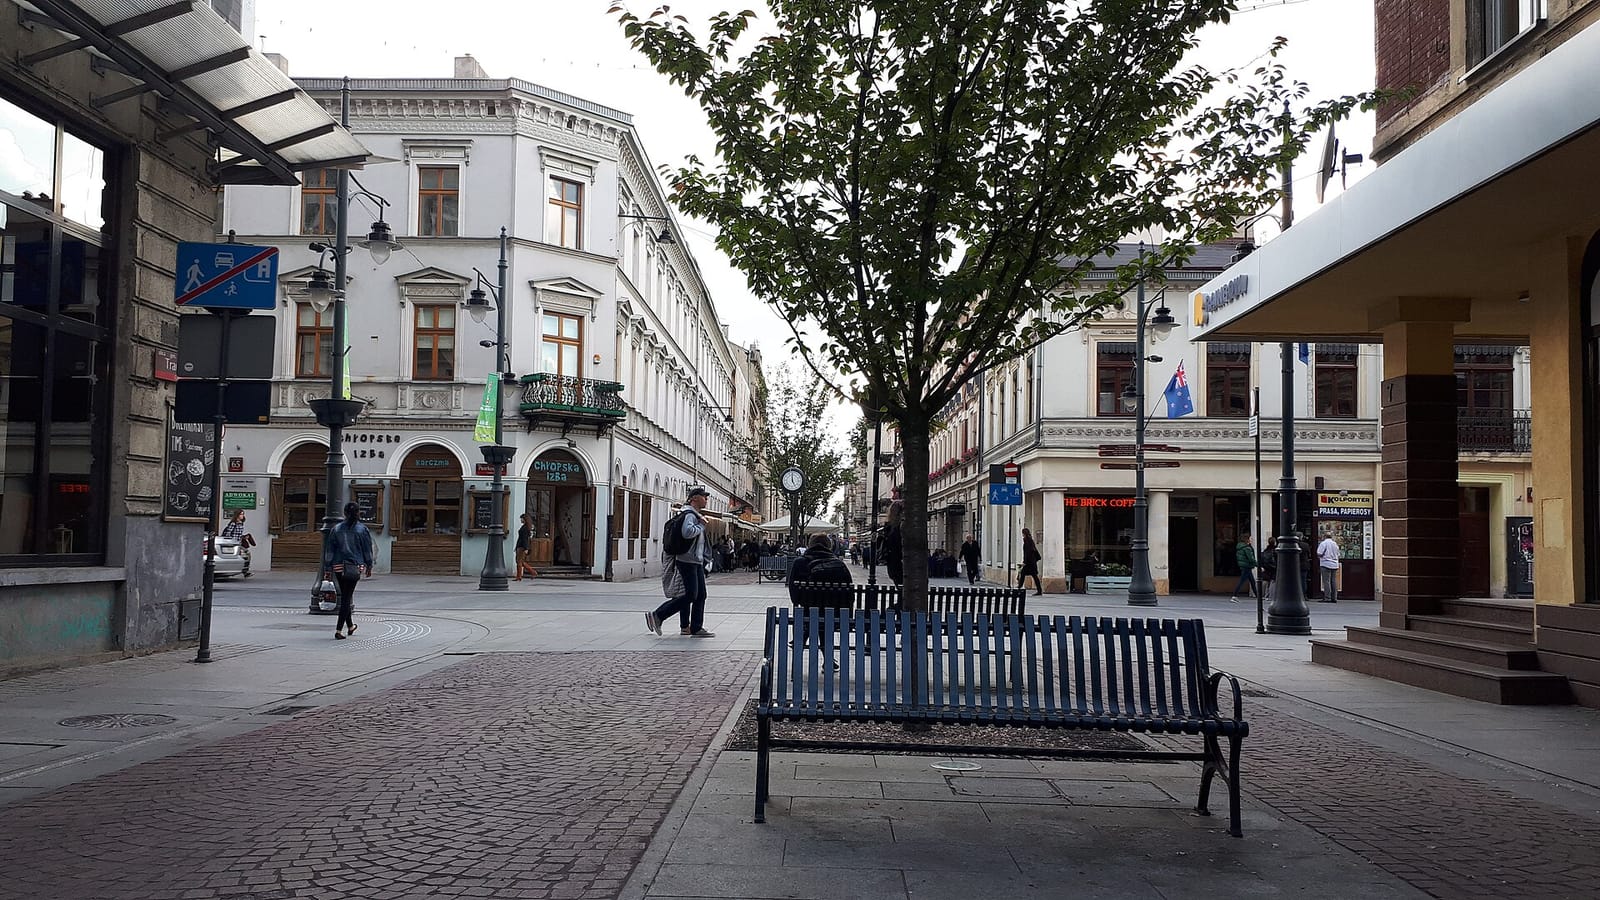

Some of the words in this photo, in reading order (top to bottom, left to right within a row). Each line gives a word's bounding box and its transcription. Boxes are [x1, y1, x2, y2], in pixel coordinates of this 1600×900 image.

[1080, 498, 1107, 507] BRICK
[1327, 496, 1370, 504] KOLPORTER
[1319, 507, 1339, 516] PRASA,
[1341, 508, 1371, 516] PAPIEROSY
